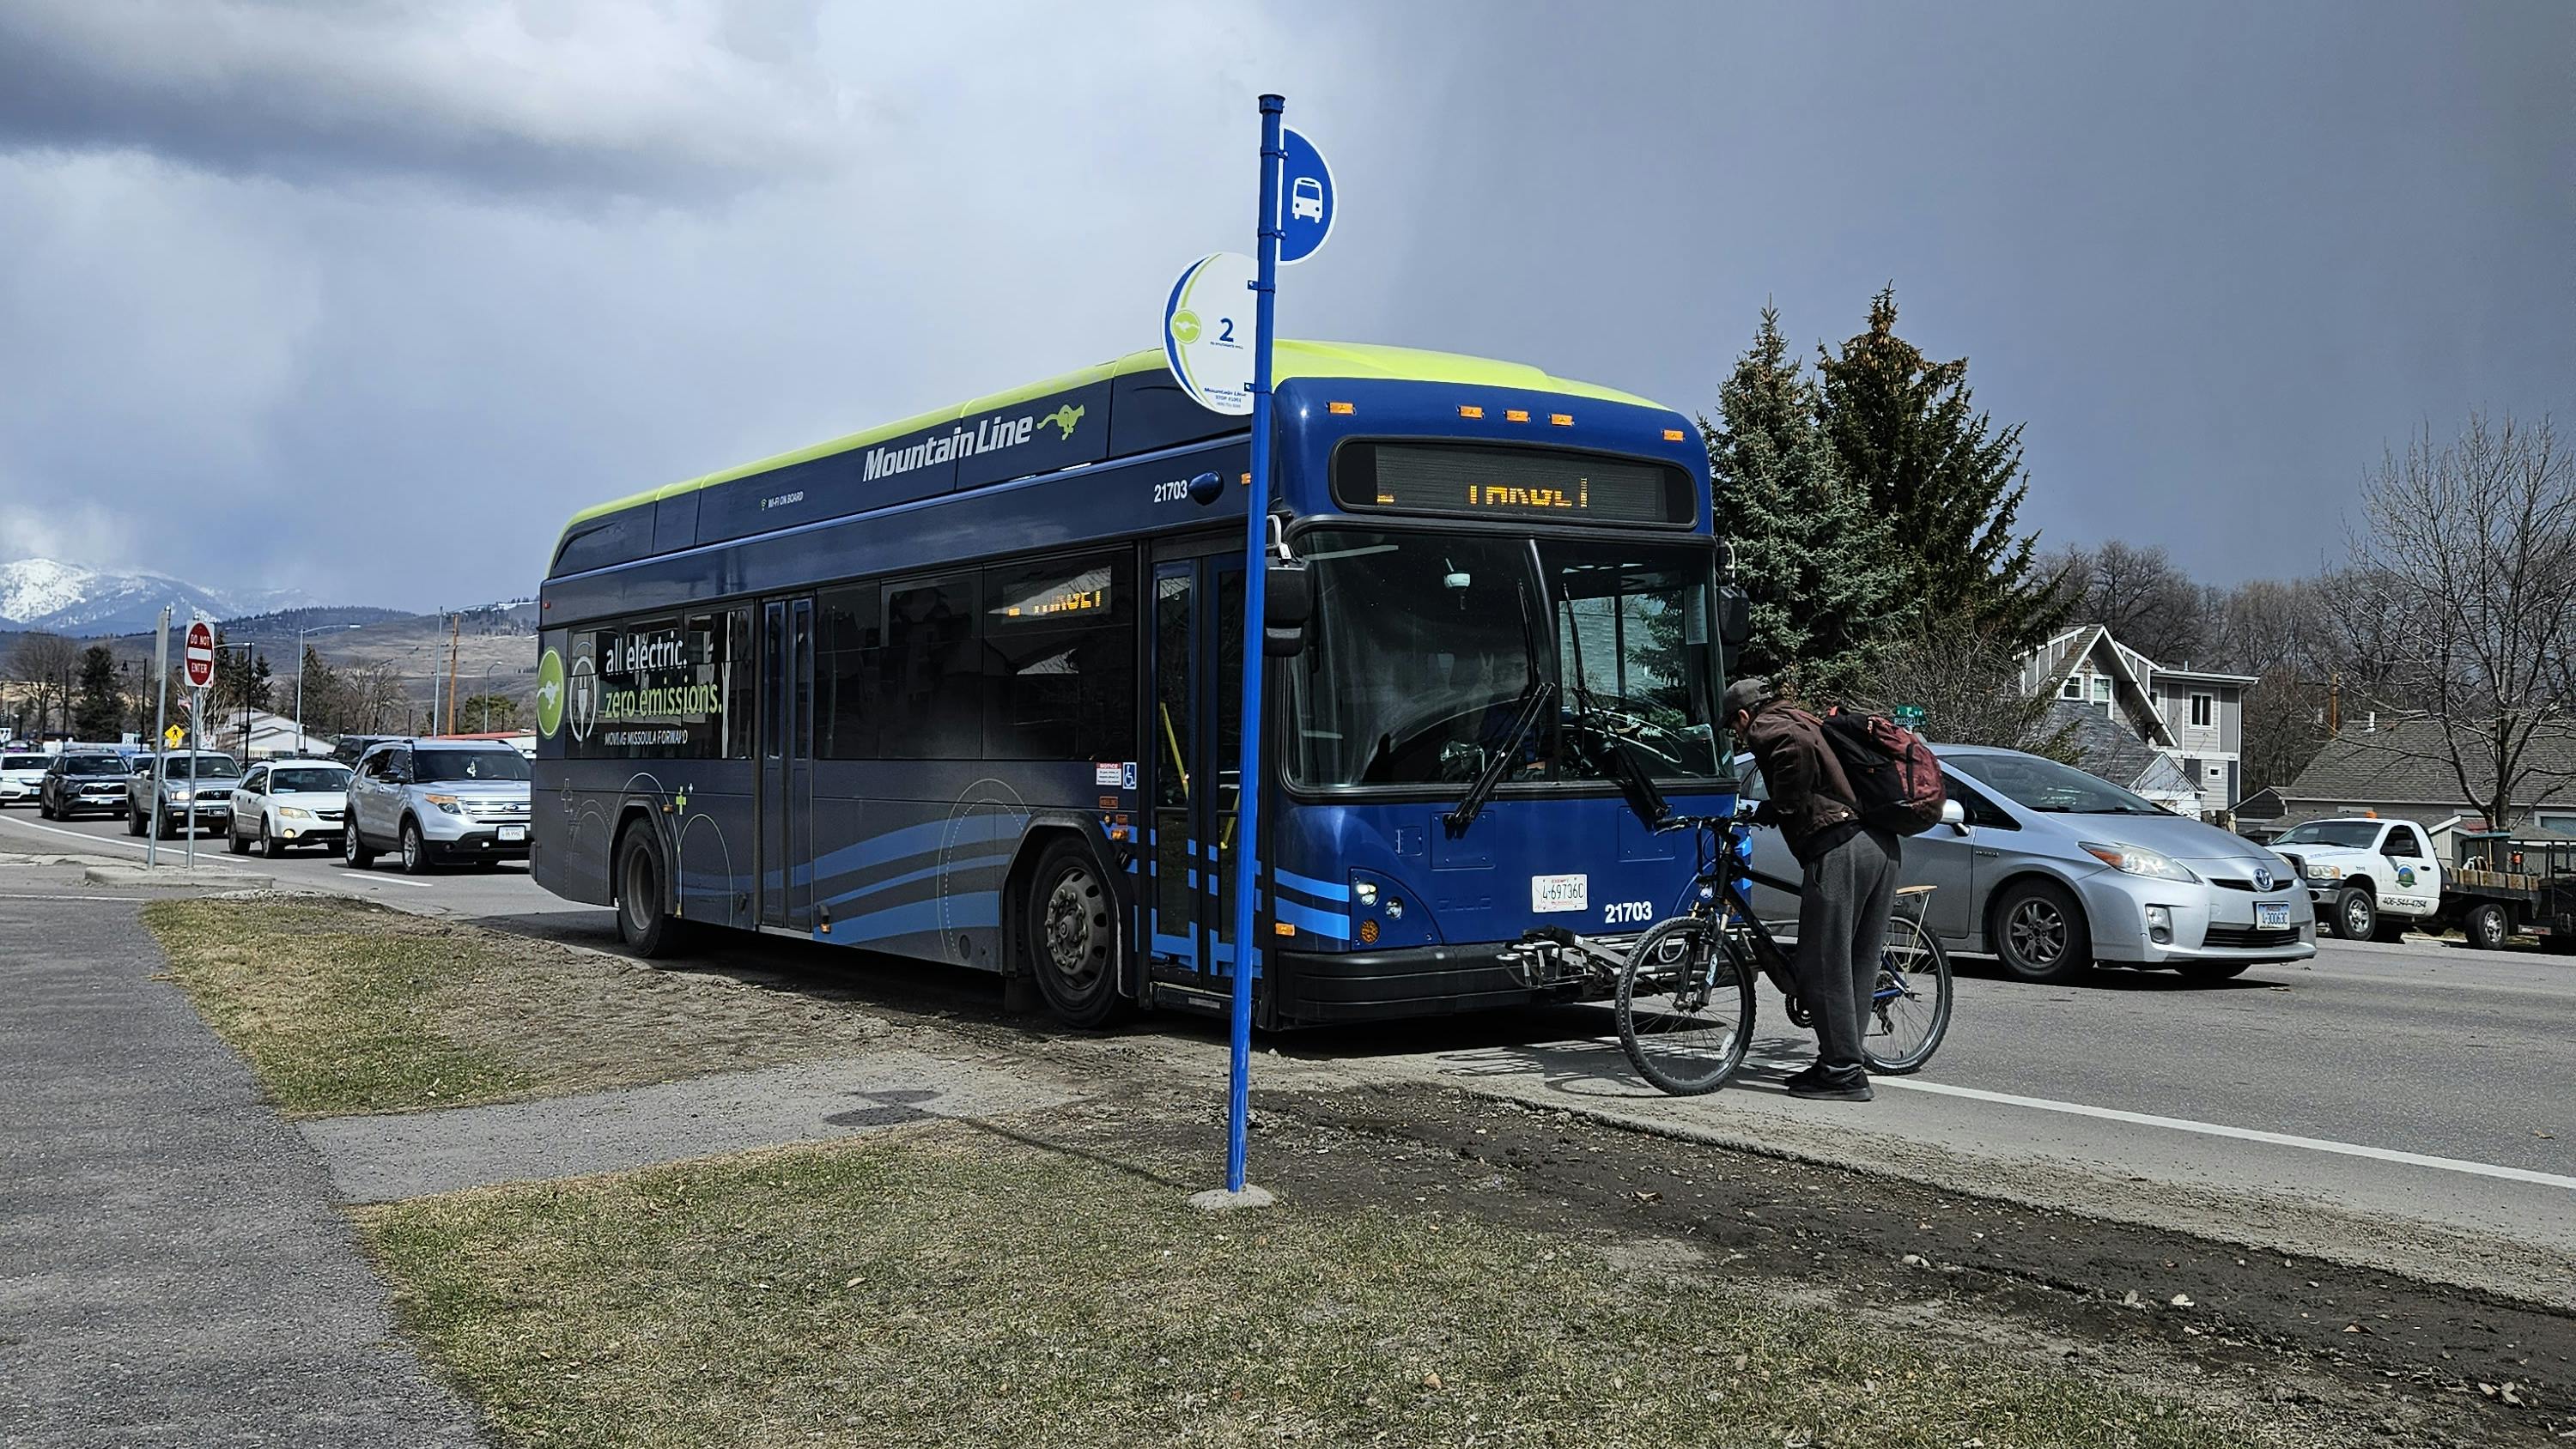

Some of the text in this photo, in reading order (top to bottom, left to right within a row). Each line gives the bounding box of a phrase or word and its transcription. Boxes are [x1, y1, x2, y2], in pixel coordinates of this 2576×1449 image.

[1219, 318, 1234, 343] 2
[862, 415, 1034, 482] Mountain Line
[1153, 479, 1188, 503] 21703
[190, 634, 210, 646] DO NOT
[605, 629, 688, 673] all electric.
[191, 662, 208, 674] ENTER
[605, 675, 722, 718] zero emissions.
[627, 731, 657, 745] MISSOULA
[1604, 900, 1653, 925] 21703
